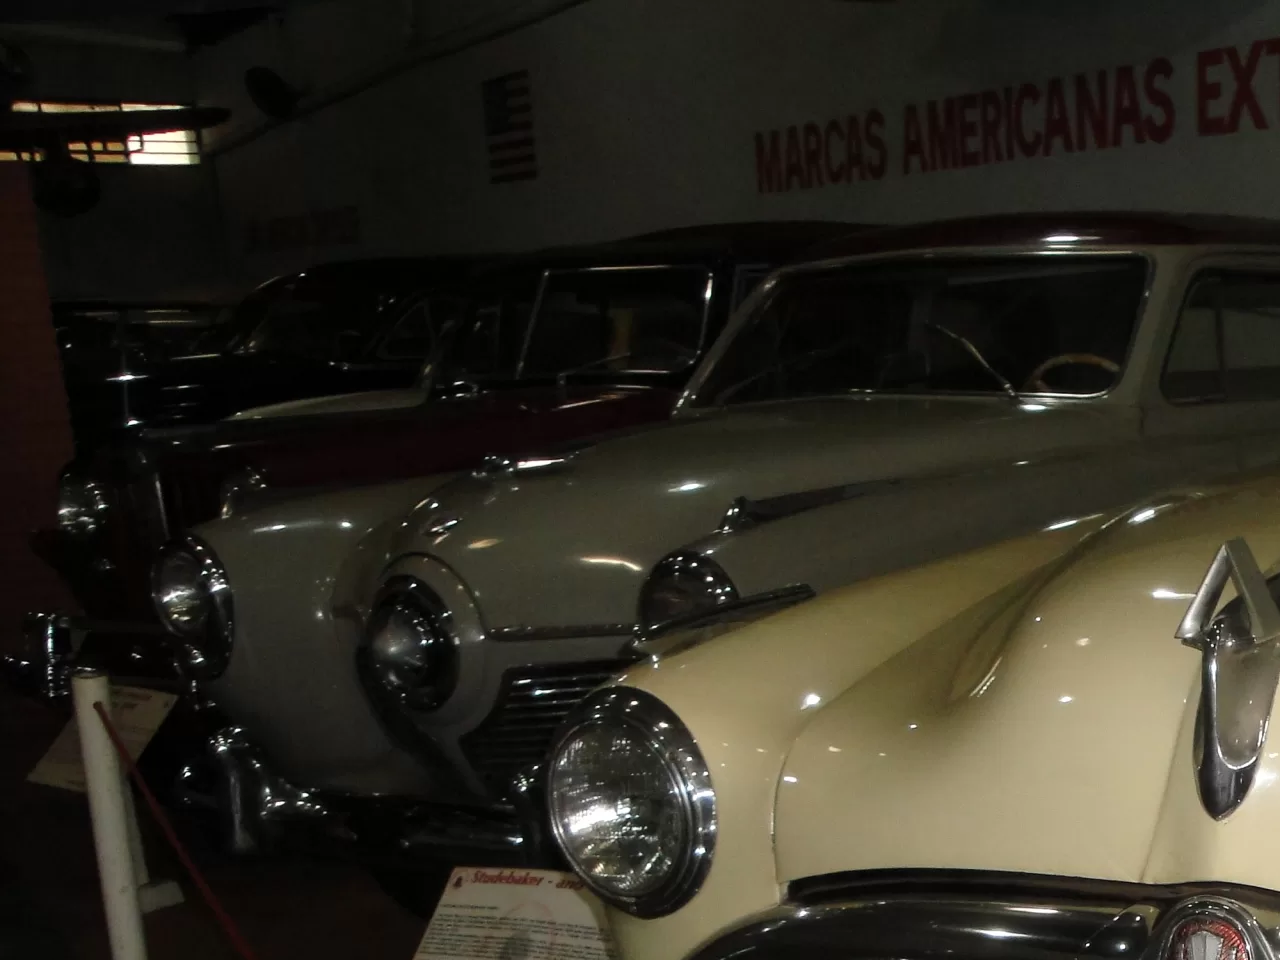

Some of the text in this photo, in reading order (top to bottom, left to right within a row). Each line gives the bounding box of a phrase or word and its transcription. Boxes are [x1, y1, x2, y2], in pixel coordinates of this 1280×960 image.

[754, 109, 888, 194] MARCAS
[904, 57, 1174, 175] AMERICANAS
[472, 870, 544, 886] Studebaker
